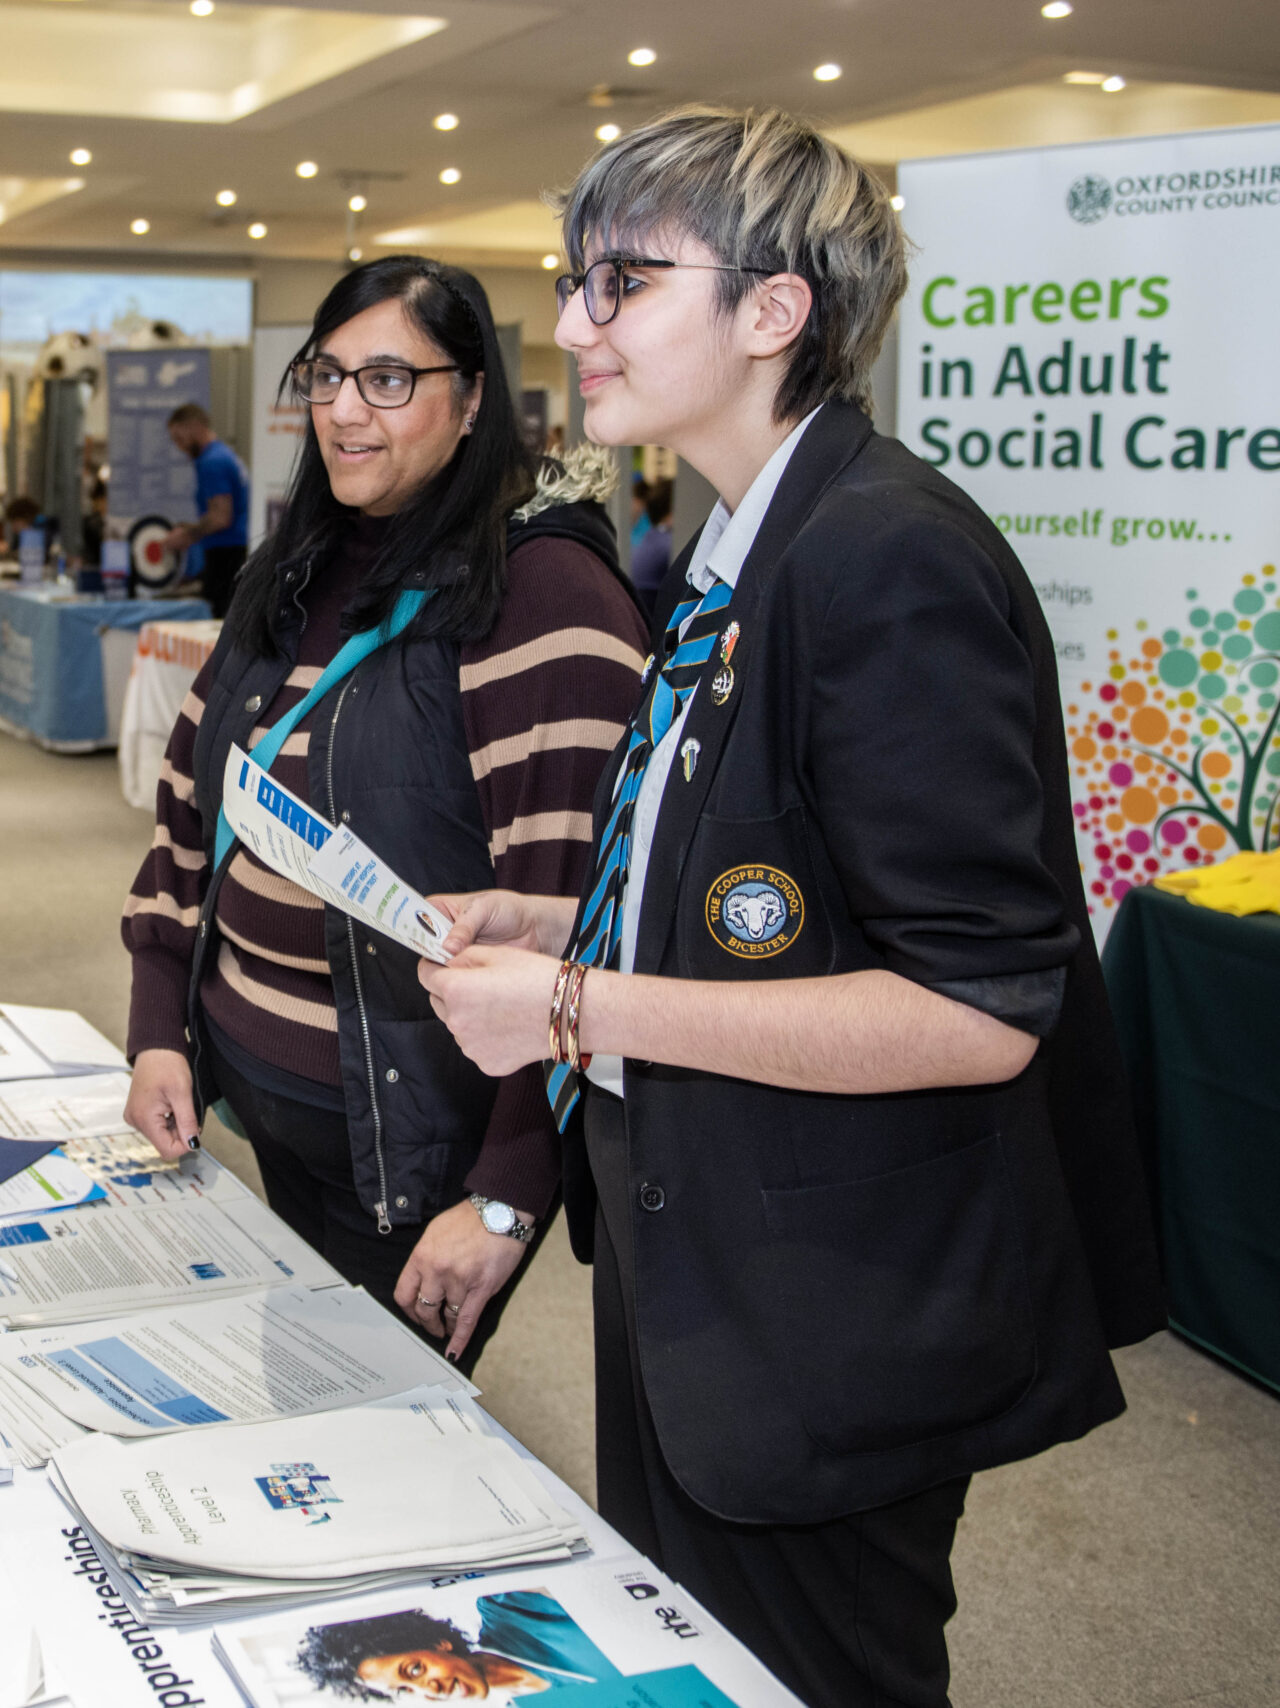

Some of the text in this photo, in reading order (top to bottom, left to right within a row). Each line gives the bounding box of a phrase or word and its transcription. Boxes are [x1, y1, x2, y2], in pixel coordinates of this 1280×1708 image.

[1115, 188, 1280, 216] COUNTY COUNC
[1116, 165, 1280, 197] OXFORDSHIR
[922, 275, 1170, 328] Careers
[922, 338, 1170, 398] in Adult
[920, 412, 1280, 471] Social Care
[991, 508, 1233, 546] ourself grow...
[710, 870, 800, 923] THE COOPER SCHOOL
[727, 933, 789, 953] BICESTER
[120, 1488, 160, 1535] Pharmacy
[145, 1470, 202, 1546] Apprenticeship
[190, 1487, 226, 1524] Level 2
[61, 1525, 206, 1708] pprenticeships
